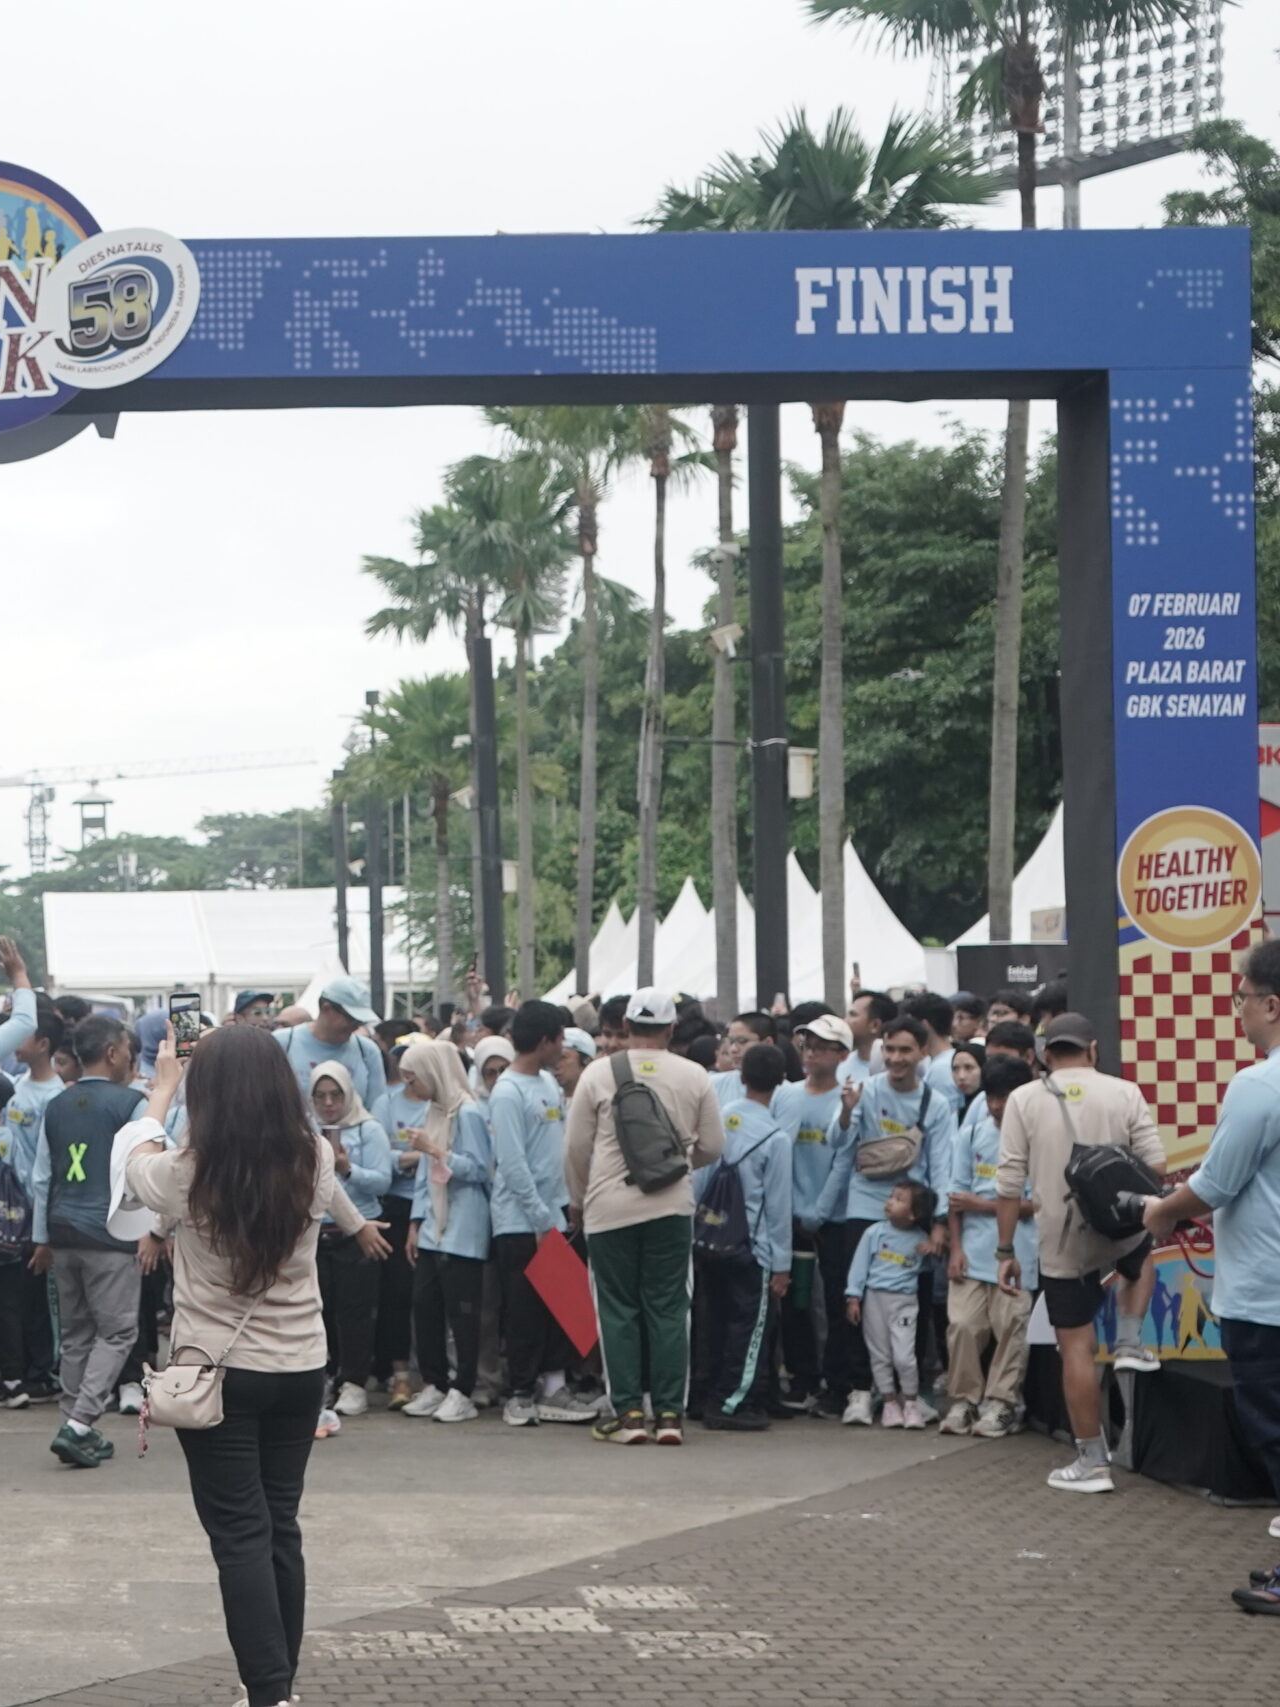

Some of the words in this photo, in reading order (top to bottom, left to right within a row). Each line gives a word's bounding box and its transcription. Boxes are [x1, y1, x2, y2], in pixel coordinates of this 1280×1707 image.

[79, 251, 106, 273] DIES
[106, 242, 164, 258] NATALIS
[69, 271, 152, 354] 58
[795, 266, 1014, 335] FINISH
[1127, 594, 1151, 617] 07
[1152, 592, 1241, 616] FEBRUARI
[1163, 627, 1206, 651] 2026
[1126, 661, 1183, 685] PLAZA
[1186, 659, 1246, 684] BARAT
[1126, 694, 1163, 718] GBK
[1166, 693, 1246, 718] SENAYAN
[1136, 845, 1239, 882] HEALTHY
[1134, 878, 1248, 916] TOGETHER
